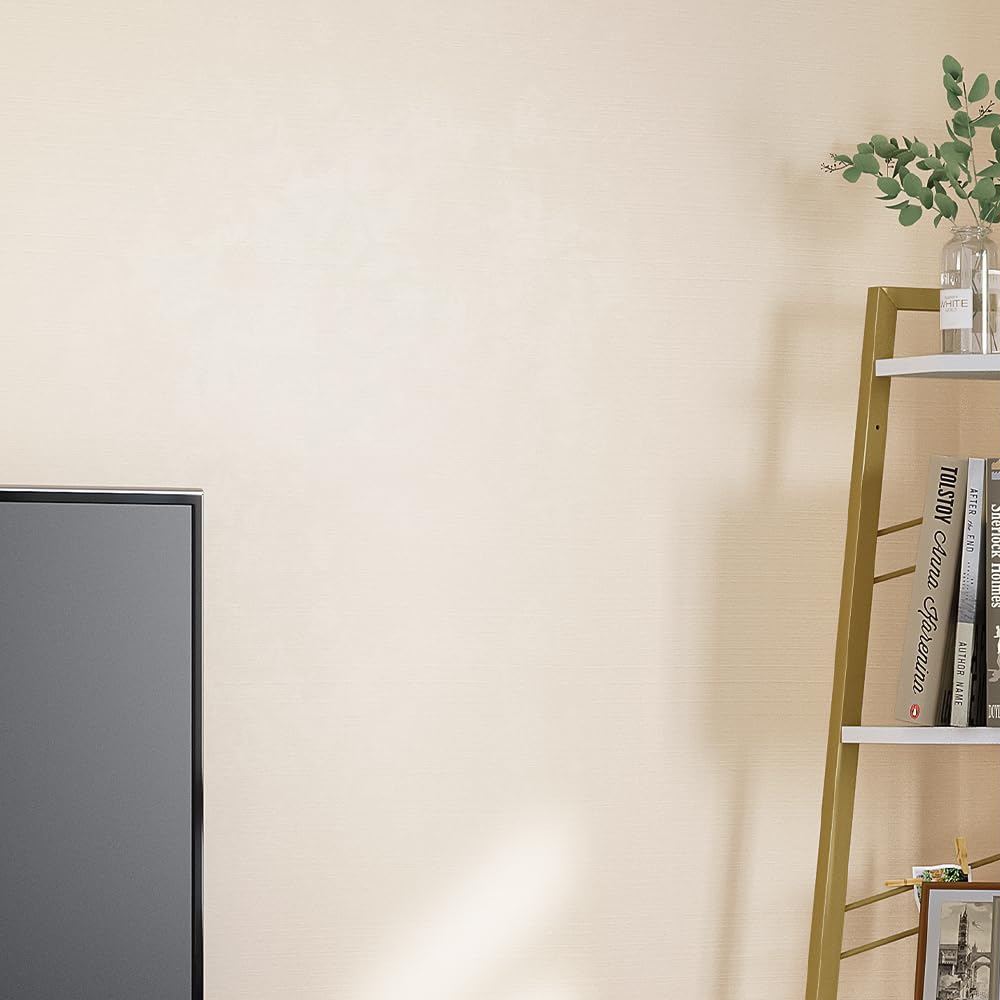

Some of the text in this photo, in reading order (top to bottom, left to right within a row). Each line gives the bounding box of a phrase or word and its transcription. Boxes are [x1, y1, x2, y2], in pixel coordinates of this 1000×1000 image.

[968, 487, 979, 515] AFTER
[965, 534, 975, 553] END
[912, 466, 958, 695] TOLSTOY Anna Karenina
[954, 640, 968, 706] AUTHOR NAME
